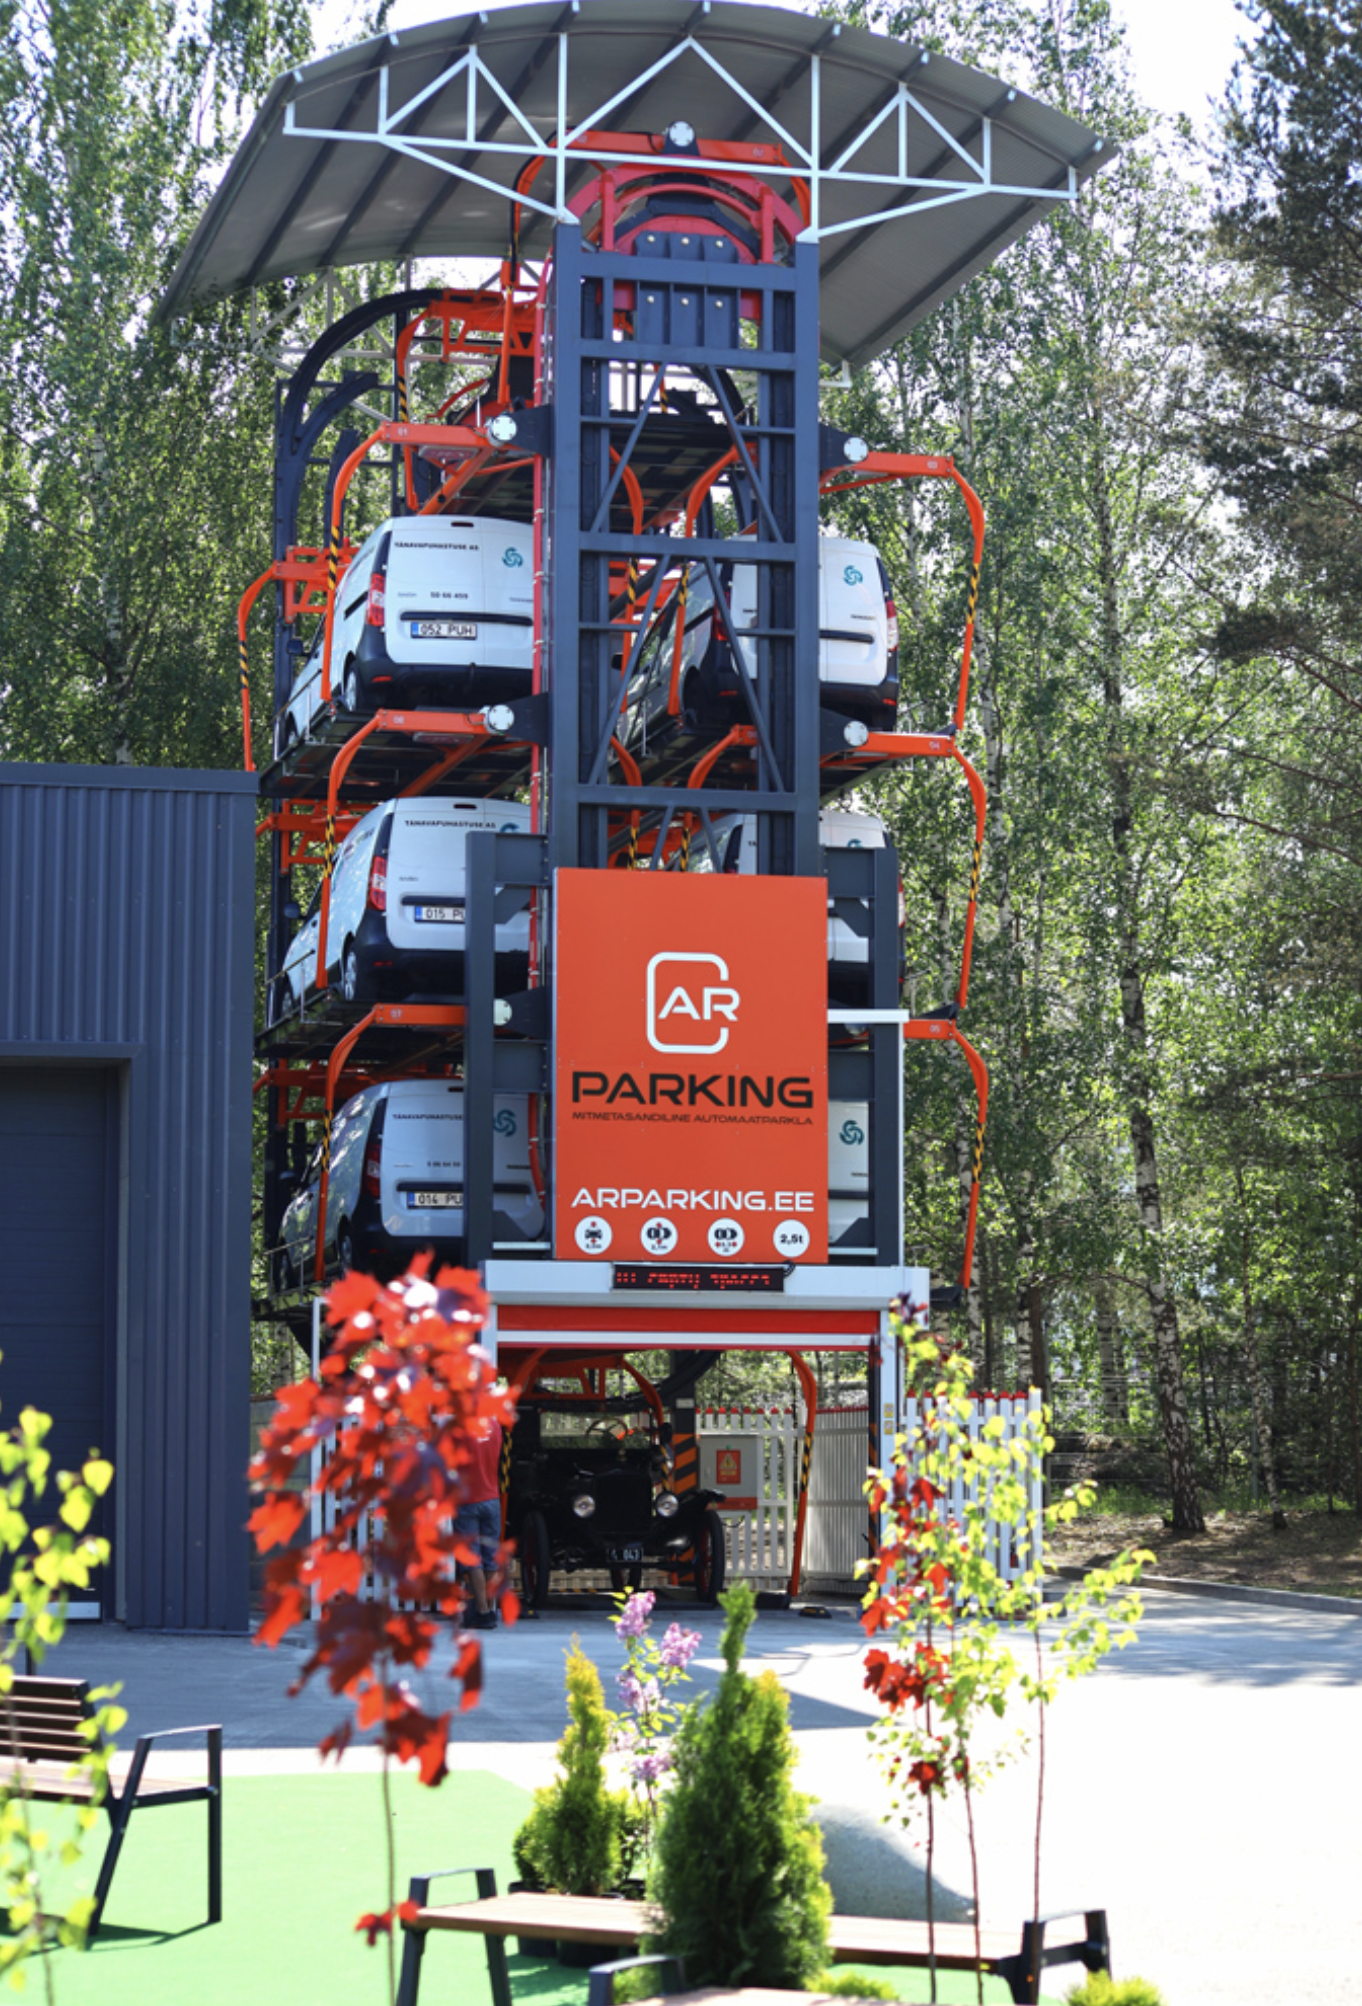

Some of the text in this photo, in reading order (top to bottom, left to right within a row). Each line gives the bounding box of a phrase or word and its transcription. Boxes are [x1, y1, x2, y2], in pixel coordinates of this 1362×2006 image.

[420, 623, 473, 636] 052 PUH
[425, 907, 446, 920] 015
[572, 1071, 814, 1109] PARKING
[572, 1111, 813, 1126] MITMETASANDILINE AUTOMAATPARKLA
[571, 1187, 815, 1213] ARPARKING.EE
[779, 1233, 804, 1246] 2,5t
